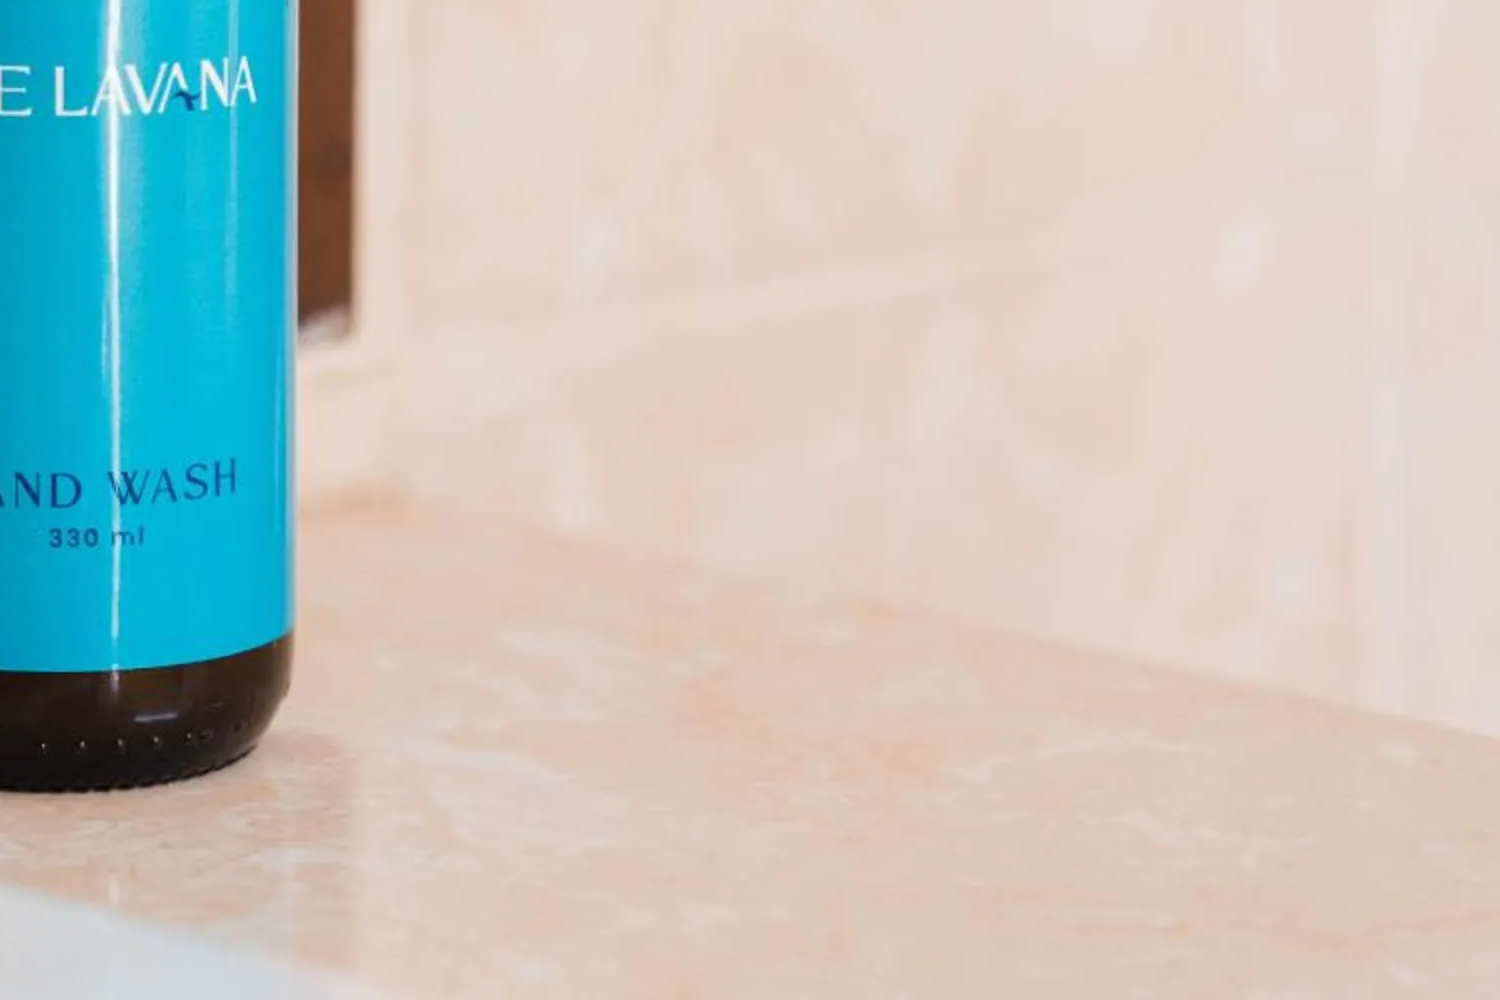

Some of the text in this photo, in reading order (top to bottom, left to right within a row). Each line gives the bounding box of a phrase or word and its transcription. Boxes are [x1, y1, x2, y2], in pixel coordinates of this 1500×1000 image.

[54, 55, 258, 118] LAVANA
[107, 457, 237, 506] WASH
[47, 525, 145, 549] 330 ml
